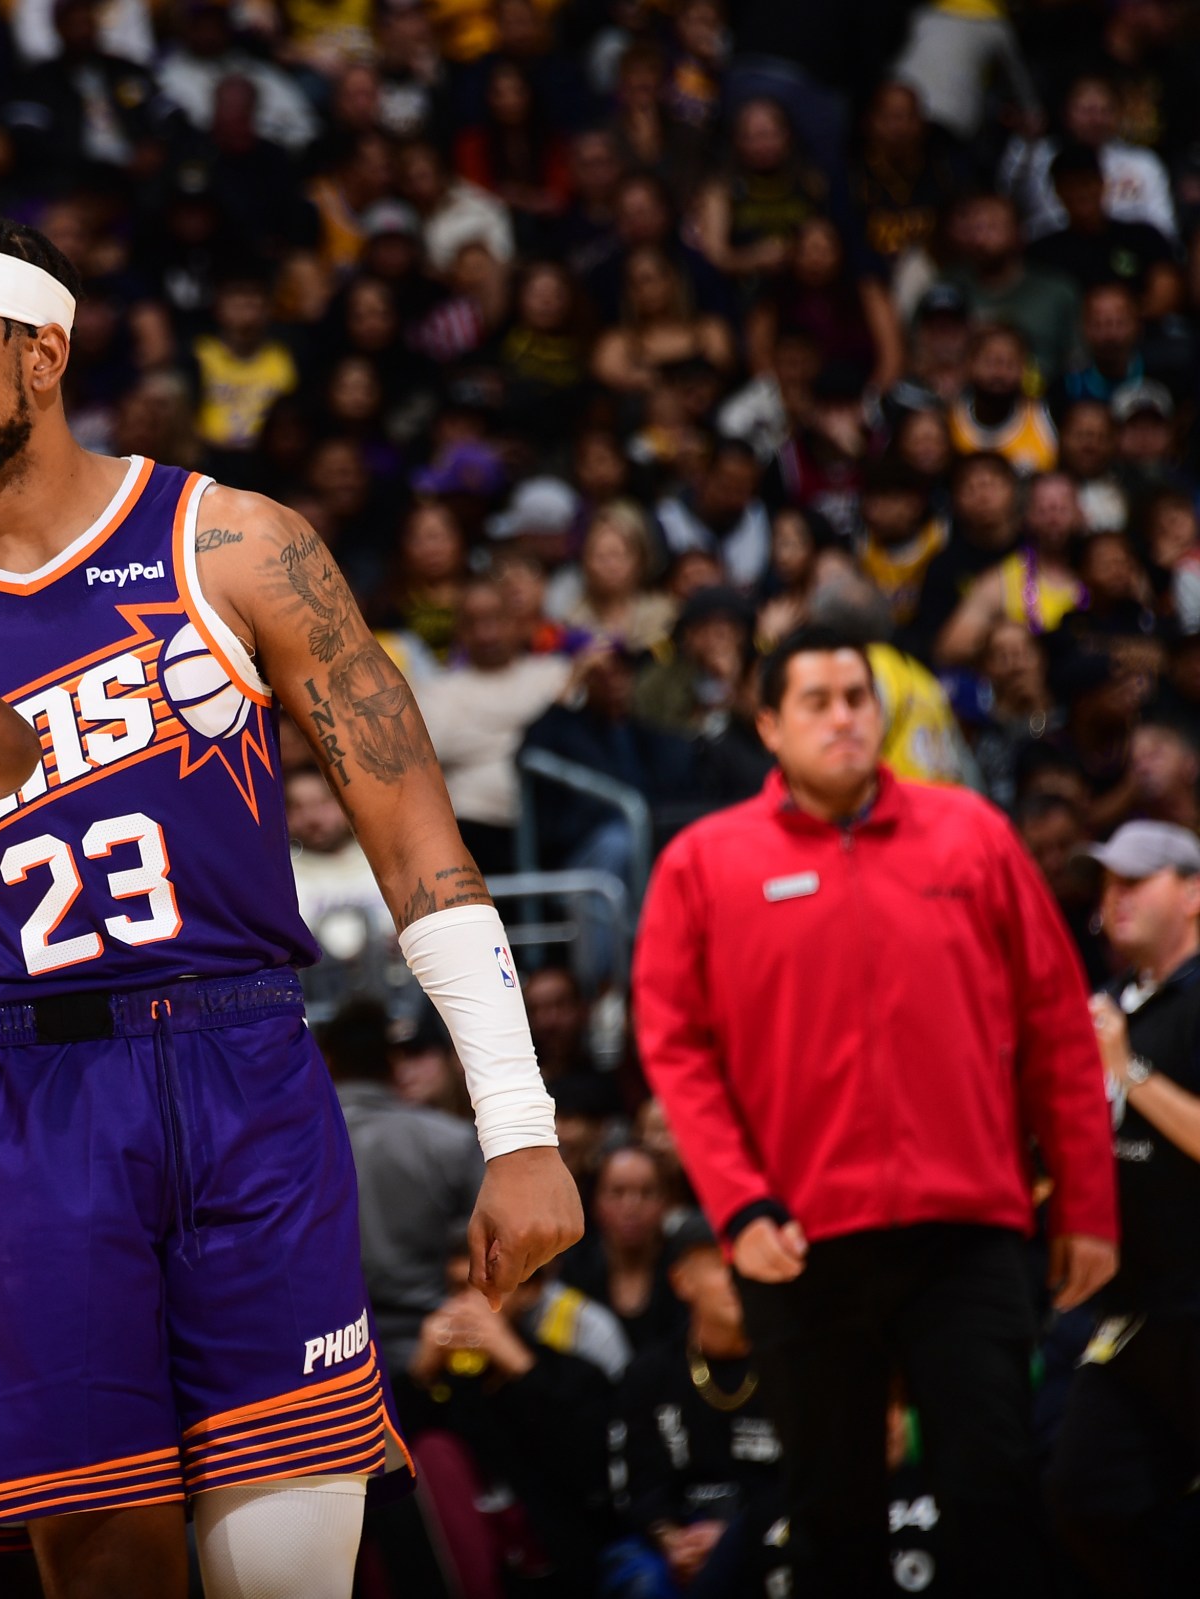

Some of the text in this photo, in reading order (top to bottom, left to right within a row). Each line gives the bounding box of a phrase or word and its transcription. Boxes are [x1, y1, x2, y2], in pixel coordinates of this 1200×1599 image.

[86, 560, 165, 588] PayPal
[196, 528, 243, 552] Blue
[304, 678, 351, 787] INRI
[0, 812, 183, 977] 23
